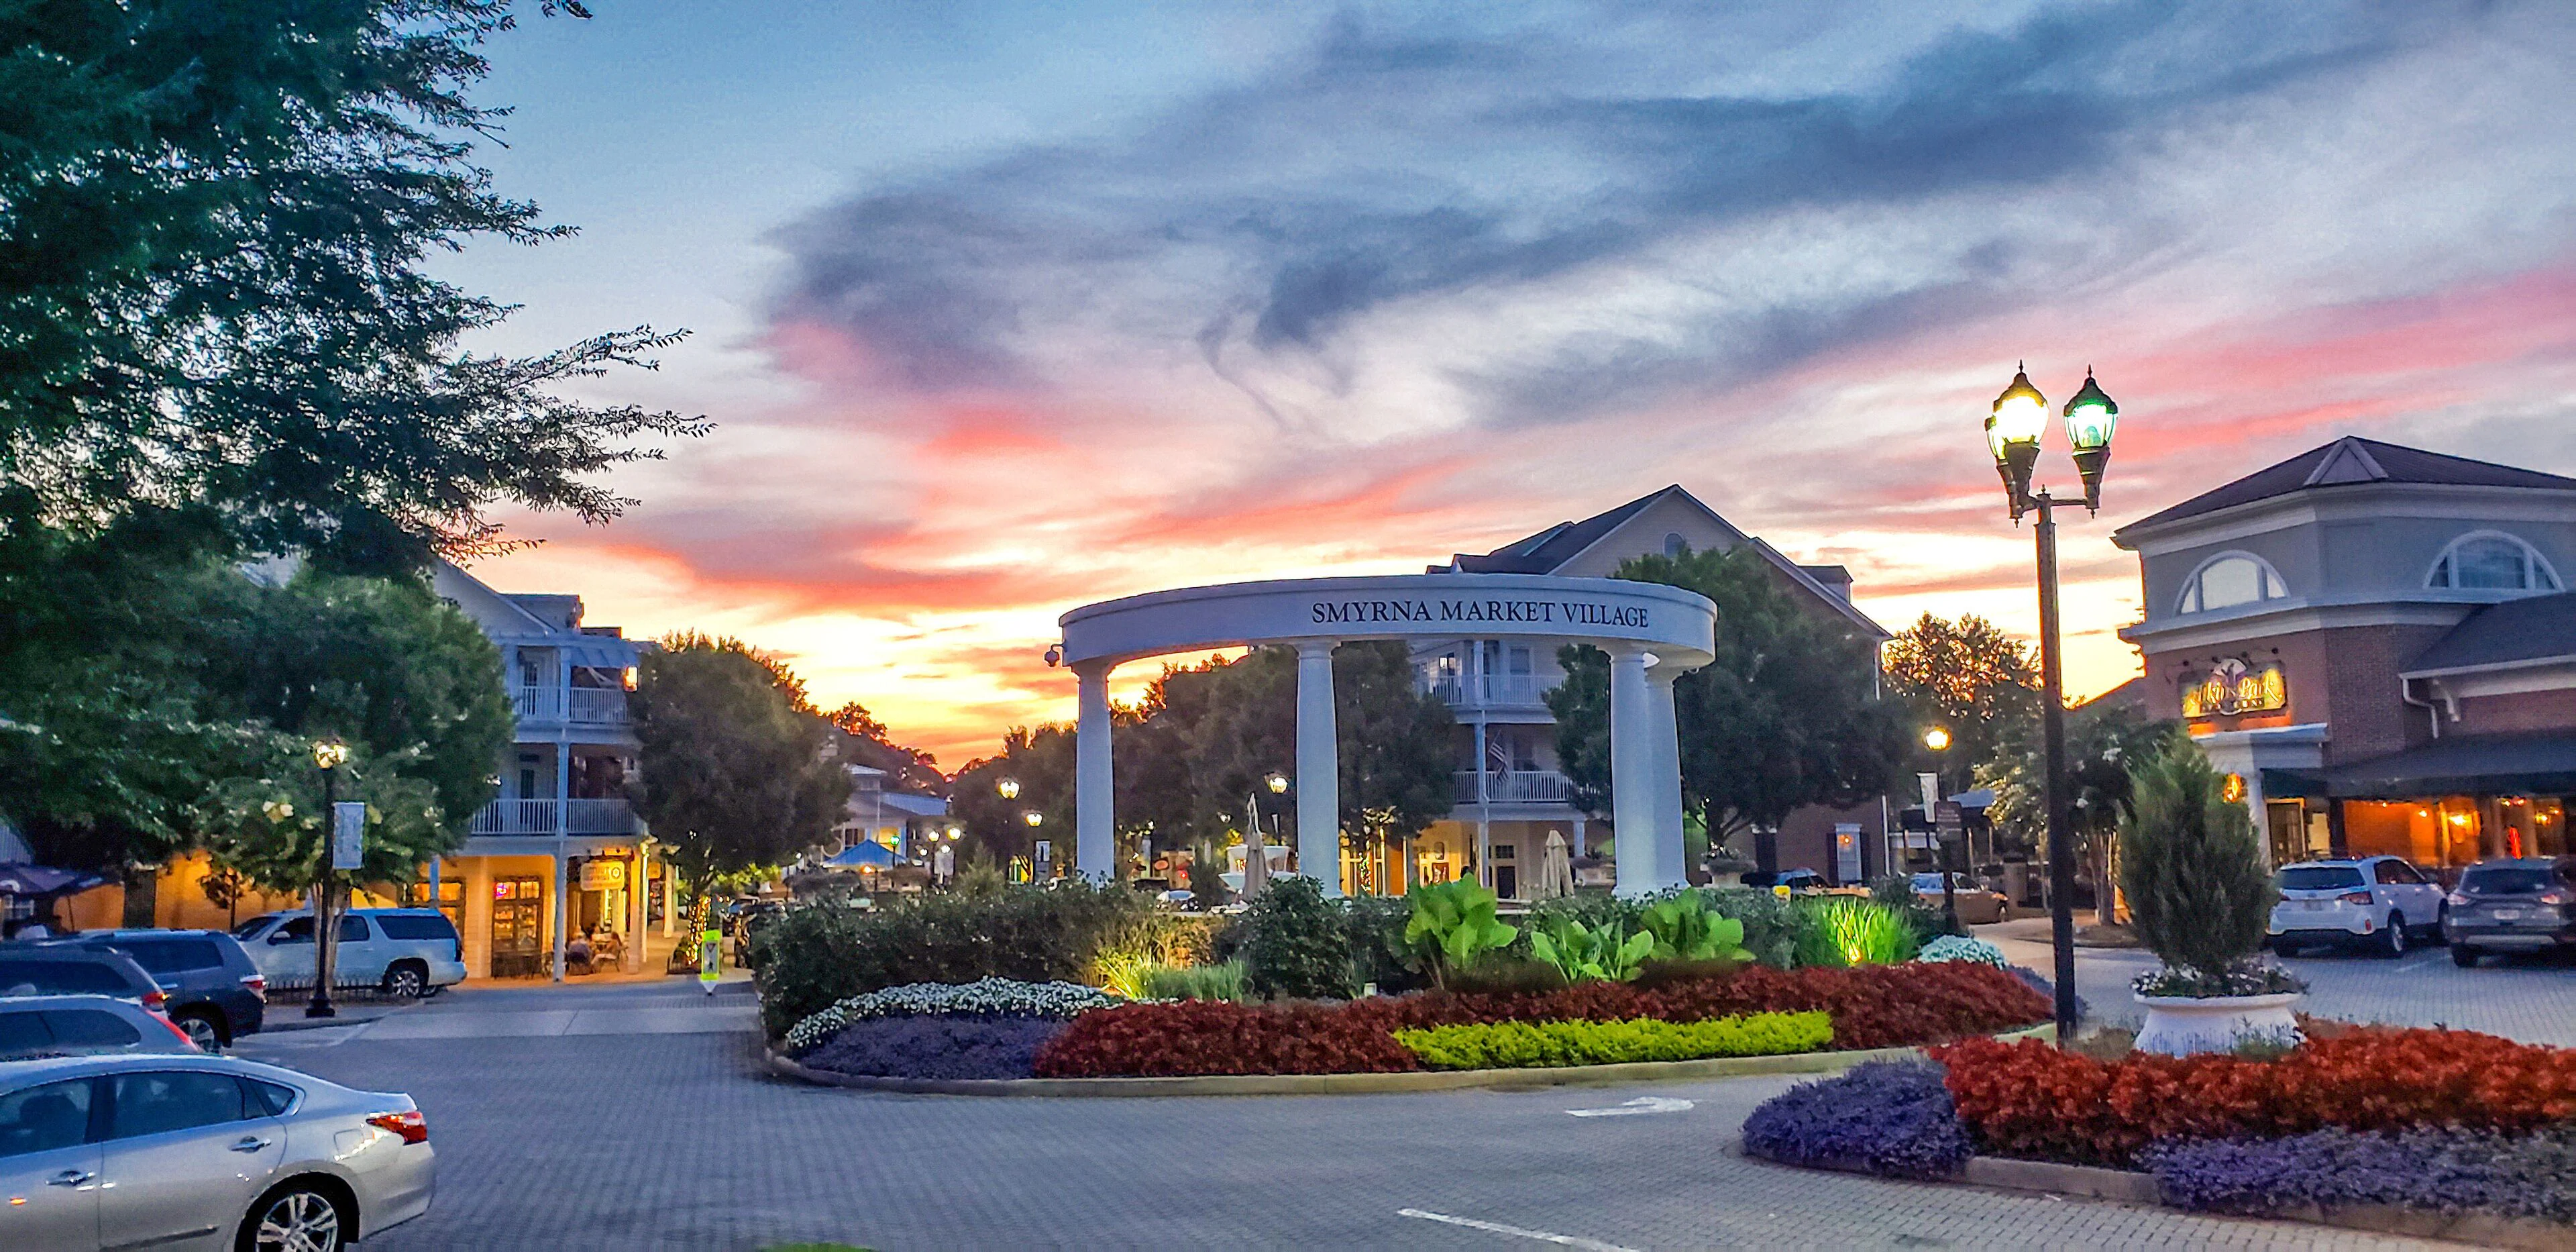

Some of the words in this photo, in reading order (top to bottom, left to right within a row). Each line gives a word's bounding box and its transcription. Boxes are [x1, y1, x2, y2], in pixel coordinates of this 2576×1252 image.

[1312, 601, 1433, 623] SMYRNA
[1440, 601, 1555, 622] MARKET
[1562, 603, 1649, 628] VILLAGE
